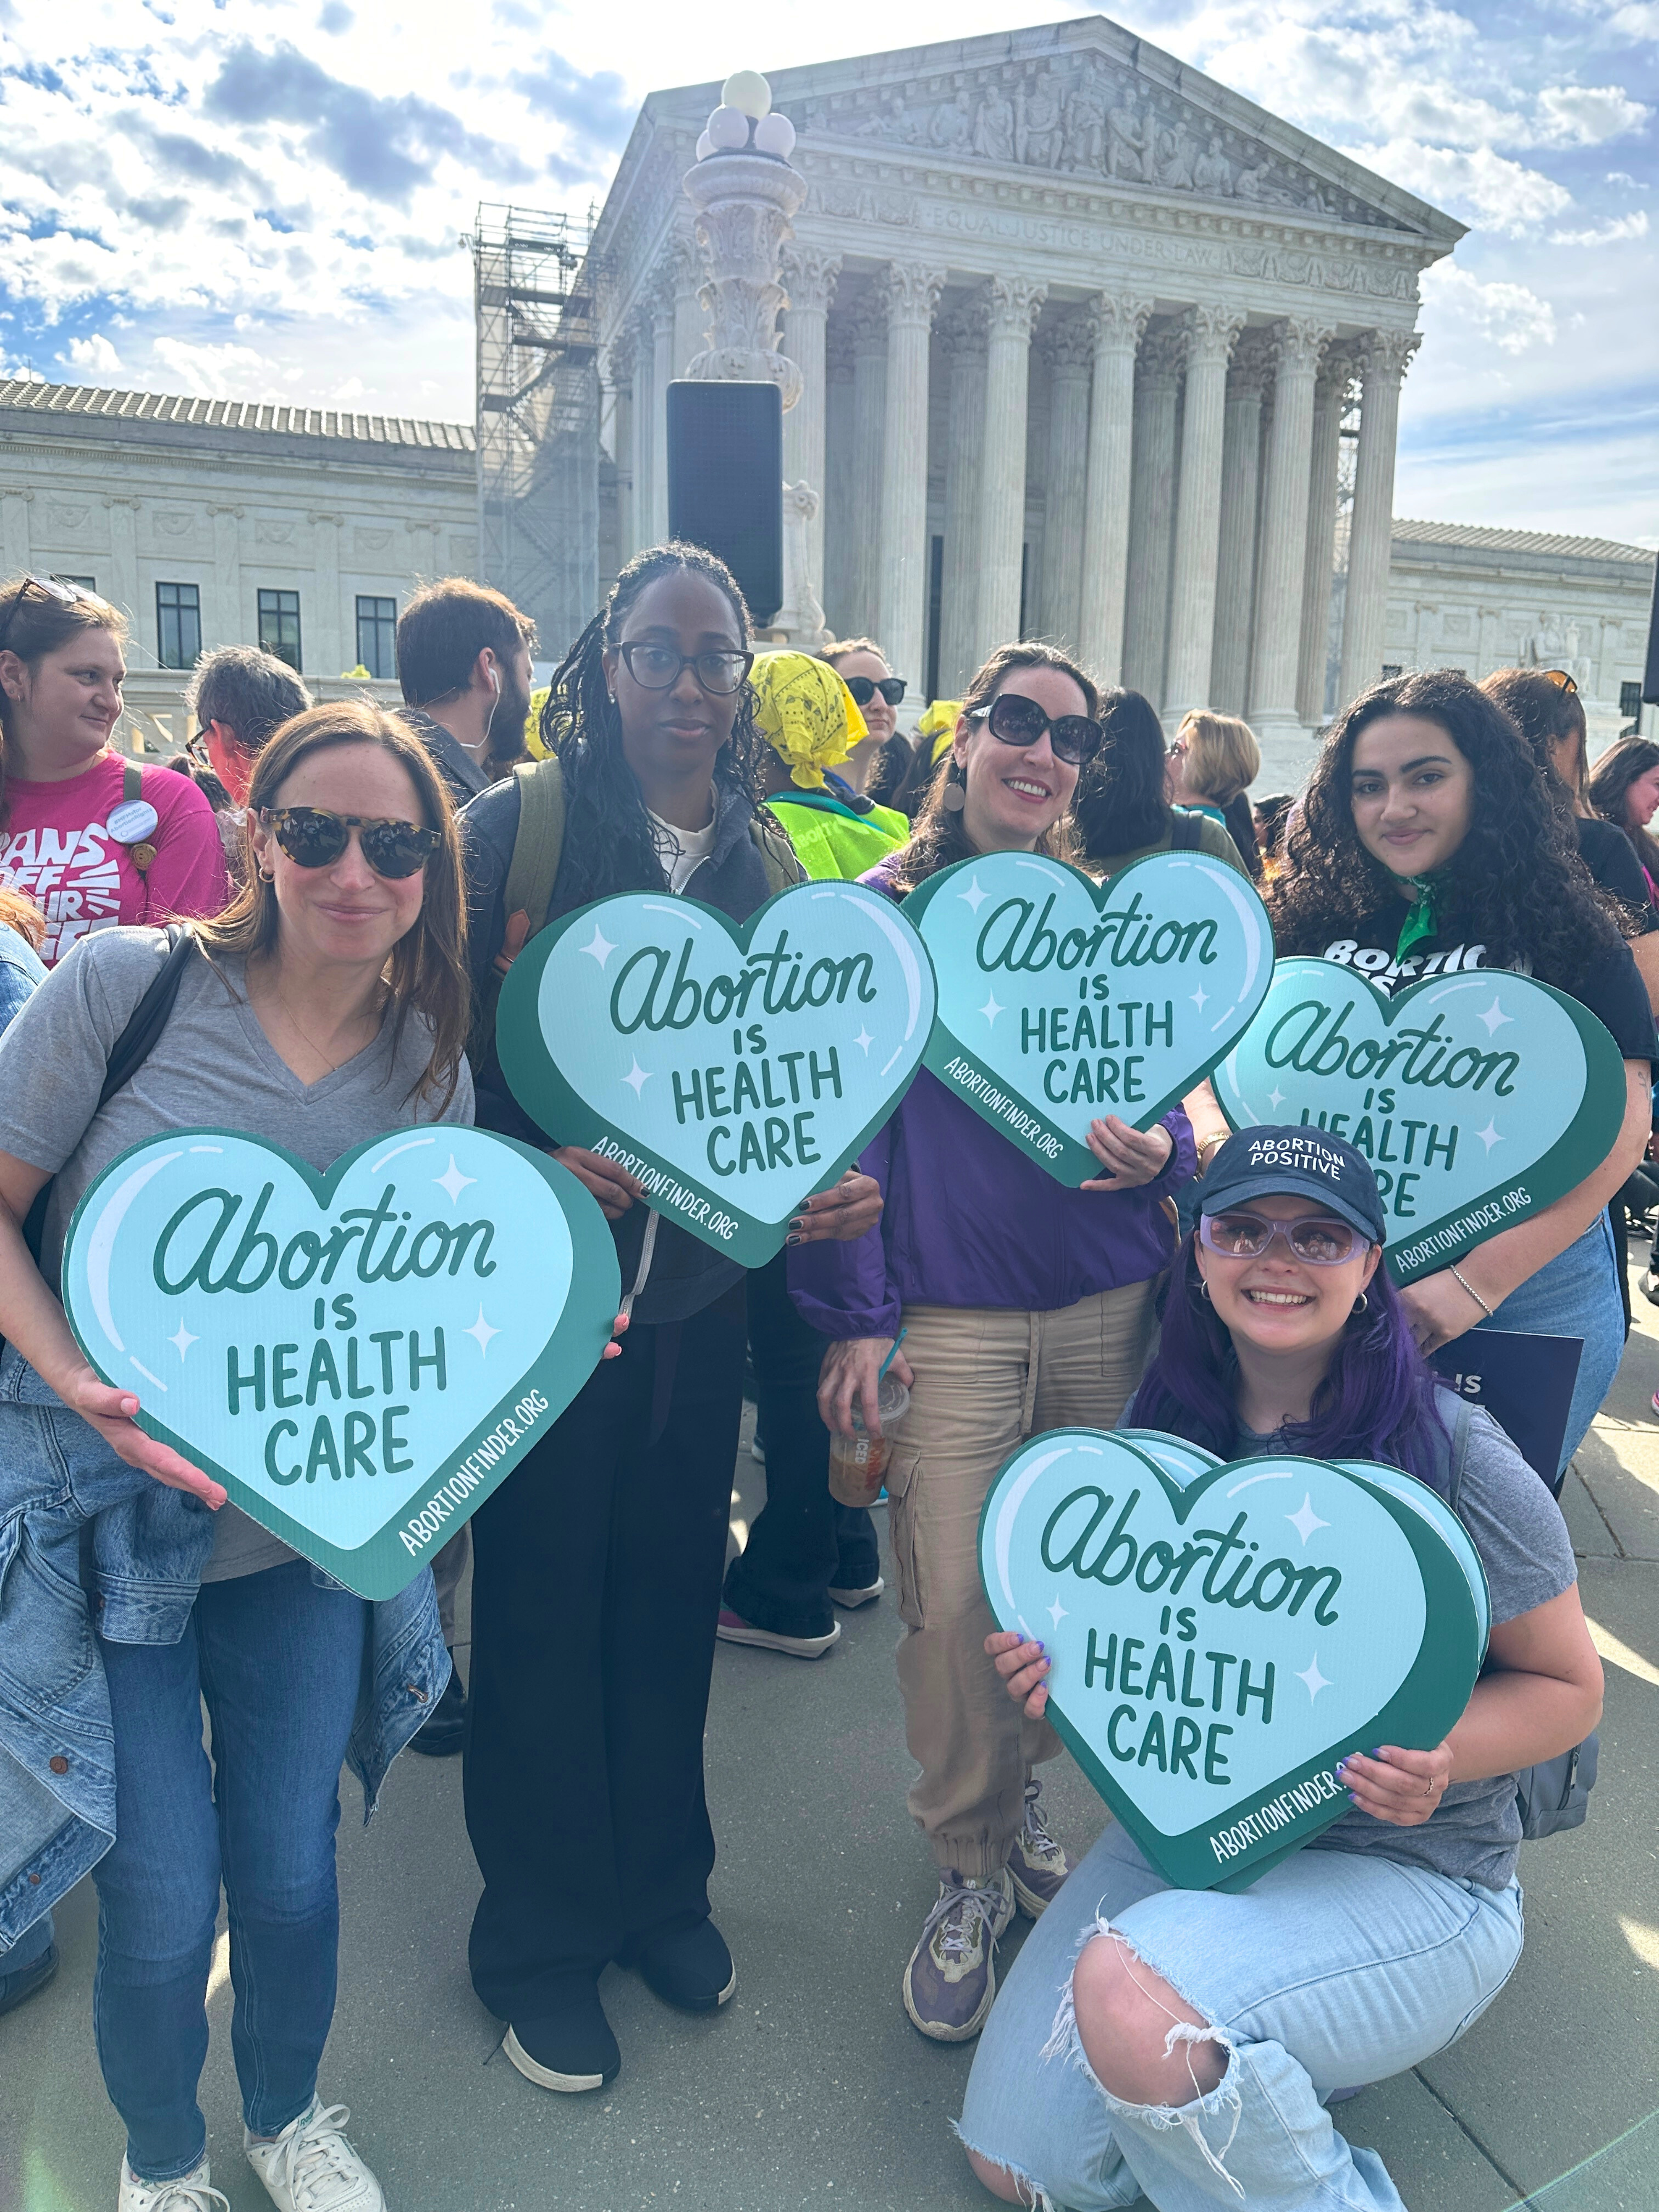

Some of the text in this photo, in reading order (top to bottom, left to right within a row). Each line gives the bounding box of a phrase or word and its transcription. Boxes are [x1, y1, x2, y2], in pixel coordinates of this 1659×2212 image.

[934, 208, 1213, 265] EQUAL JUSTICE UNDER LAW
[0, 823, 108, 868] ANS
[35, 890, 84, 922] UR
[977, 893, 1217, 972] Abortion
[610, 930, 877, 1034] Abortion
[1079, 974, 1109, 1000] IS
[734, 1024, 766, 1055] IS
[1022, 1000, 1172, 1054] HEALTH
[1265, 1001, 1519, 1096] Abortion
[672, 1046, 842, 1124] HEALTH
[944, 1056, 1063, 1159] ABORTIONFINDER.ORG
[1044, 1056, 1145, 1104] CARE
[1364, 1088, 1395, 1114] IS
[707, 1111, 821, 1176] CARE
[1248, 1138, 1346, 1167] ABORTION
[1251, 1151, 1341, 1181] POSITIVE
[591, 1136, 739, 1240] ABORTIONFINDER.ORG
[1373, 1169, 1420, 1217] RE
[153, 1182, 496, 1295] Abortion
[1395, 1187, 1532, 1273] ABORTIONFINDER.ORG
[314, 1294, 356, 1330] IS
[227, 1326, 446, 1415] HEALTH
[1454, 1373, 1482, 1393] IS
[265, 1405, 413, 1485] CARE
[398, 1389, 548, 1556] ABORTIONFINDER.ORG
[854, 1438, 869, 1464] ICED
[1041, 1486, 1342, 1626] Abortion
[1160, 1606, 1197, 1641] IS
[1085, 1628, 1275, 1724] HEALTH
[1108, 1704, 1233, 1785] CARE
[1209, 1752, 1364, 1864] ABORTIONFINDER.
